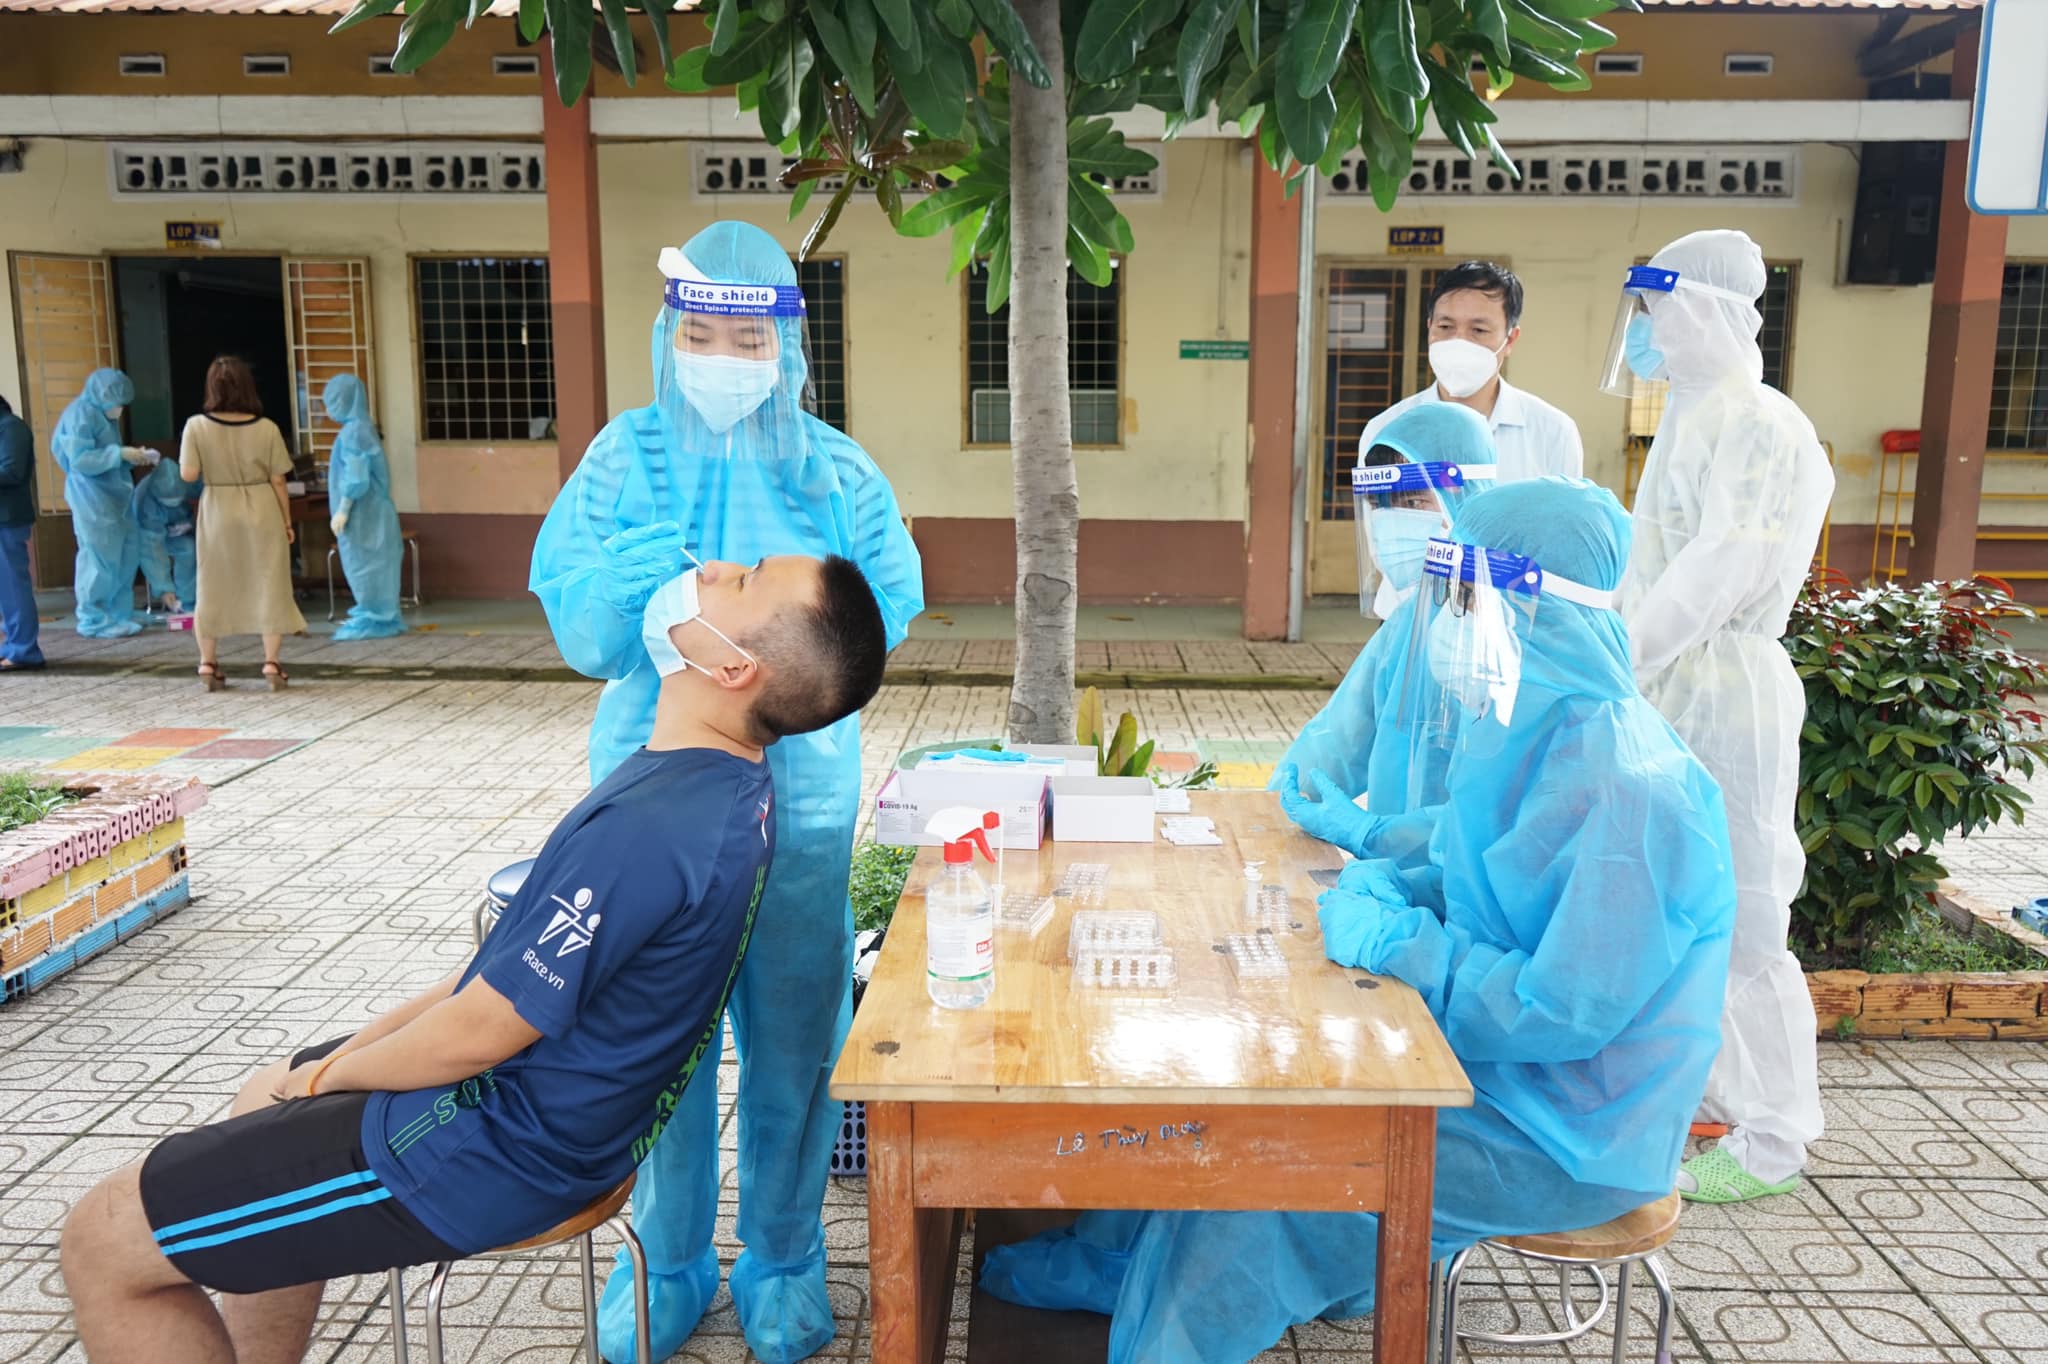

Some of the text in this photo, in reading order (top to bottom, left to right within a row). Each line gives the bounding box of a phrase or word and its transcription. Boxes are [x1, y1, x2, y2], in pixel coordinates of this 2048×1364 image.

[683, 286, 715, 300] Face
[721, 289, 769, 302] shield
[685, 302, 768, 315] Direct Splash protection
[1359, 469, 1393, 481] shield
[522, 947, 565, 990] iRace.vn
